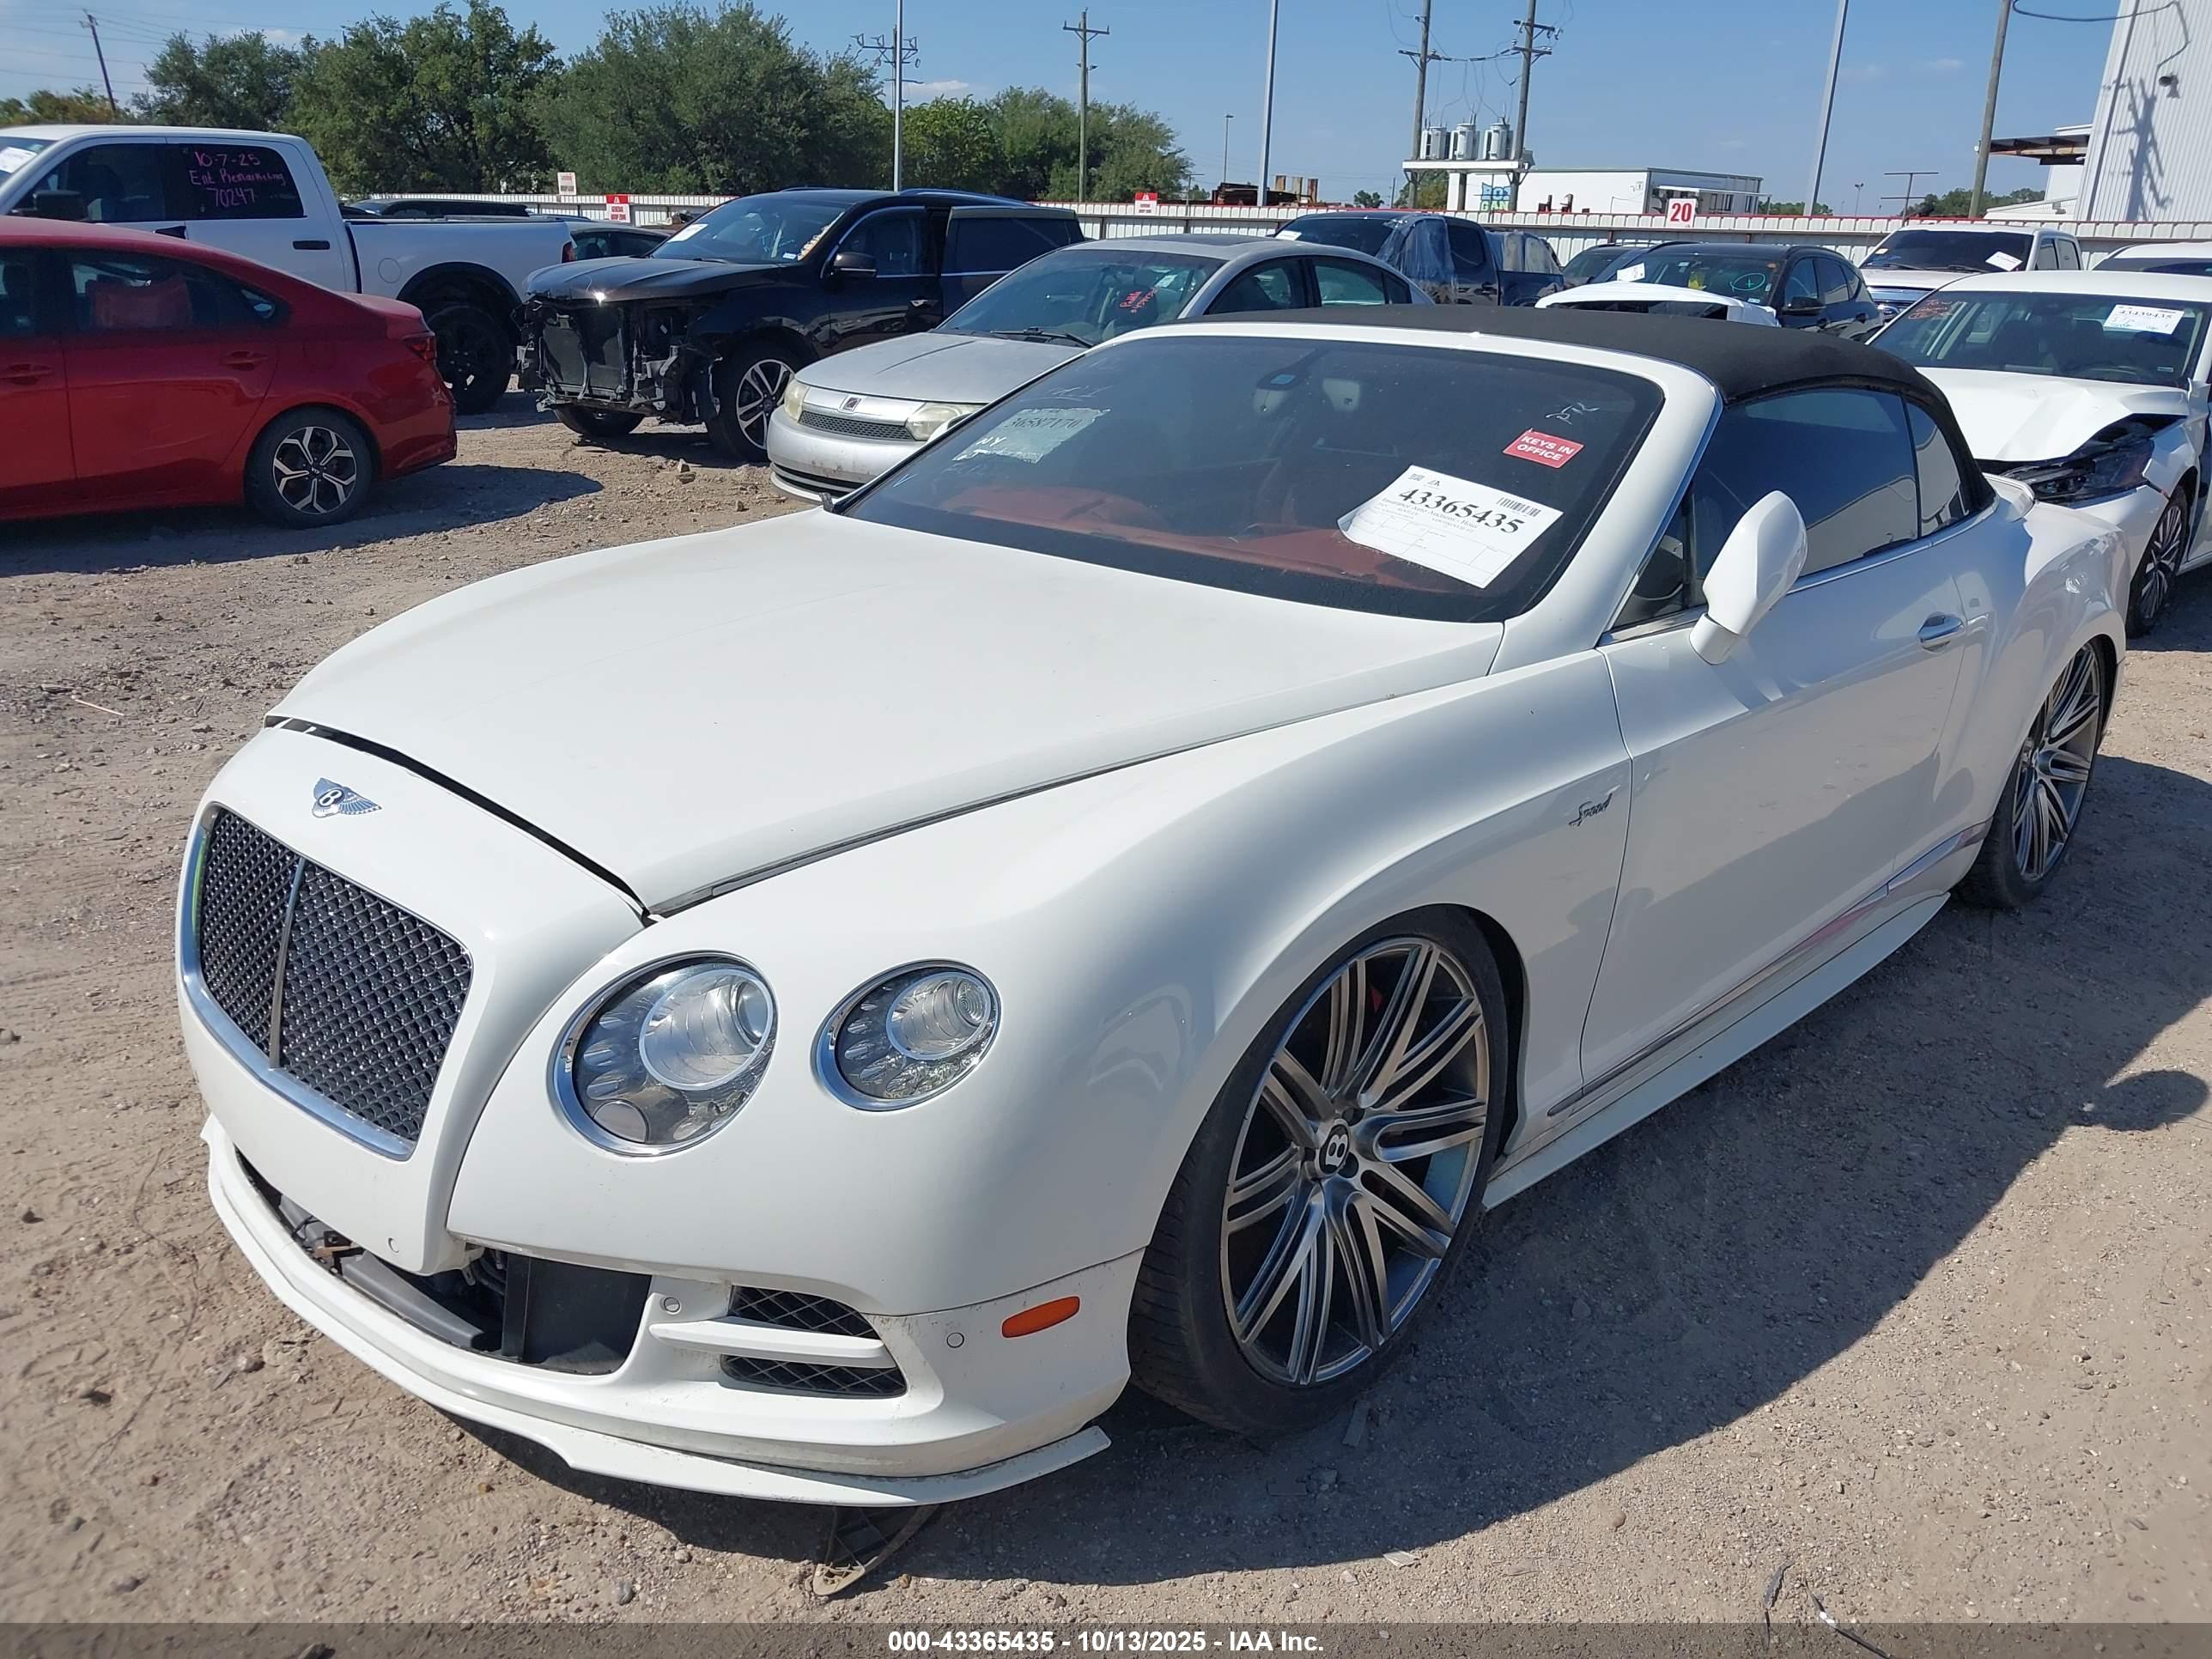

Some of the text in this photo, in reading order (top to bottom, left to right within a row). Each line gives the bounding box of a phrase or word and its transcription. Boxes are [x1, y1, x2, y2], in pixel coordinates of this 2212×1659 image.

[1670, 203, 1692, 222] 20
[1516, 444, 1563, 461] OFFICE
[1521, 435, 1575, 455] KEYS IN
[1398, 489, 1525, 534] 43365435
[1326, 1133, 1348, 1167] B
